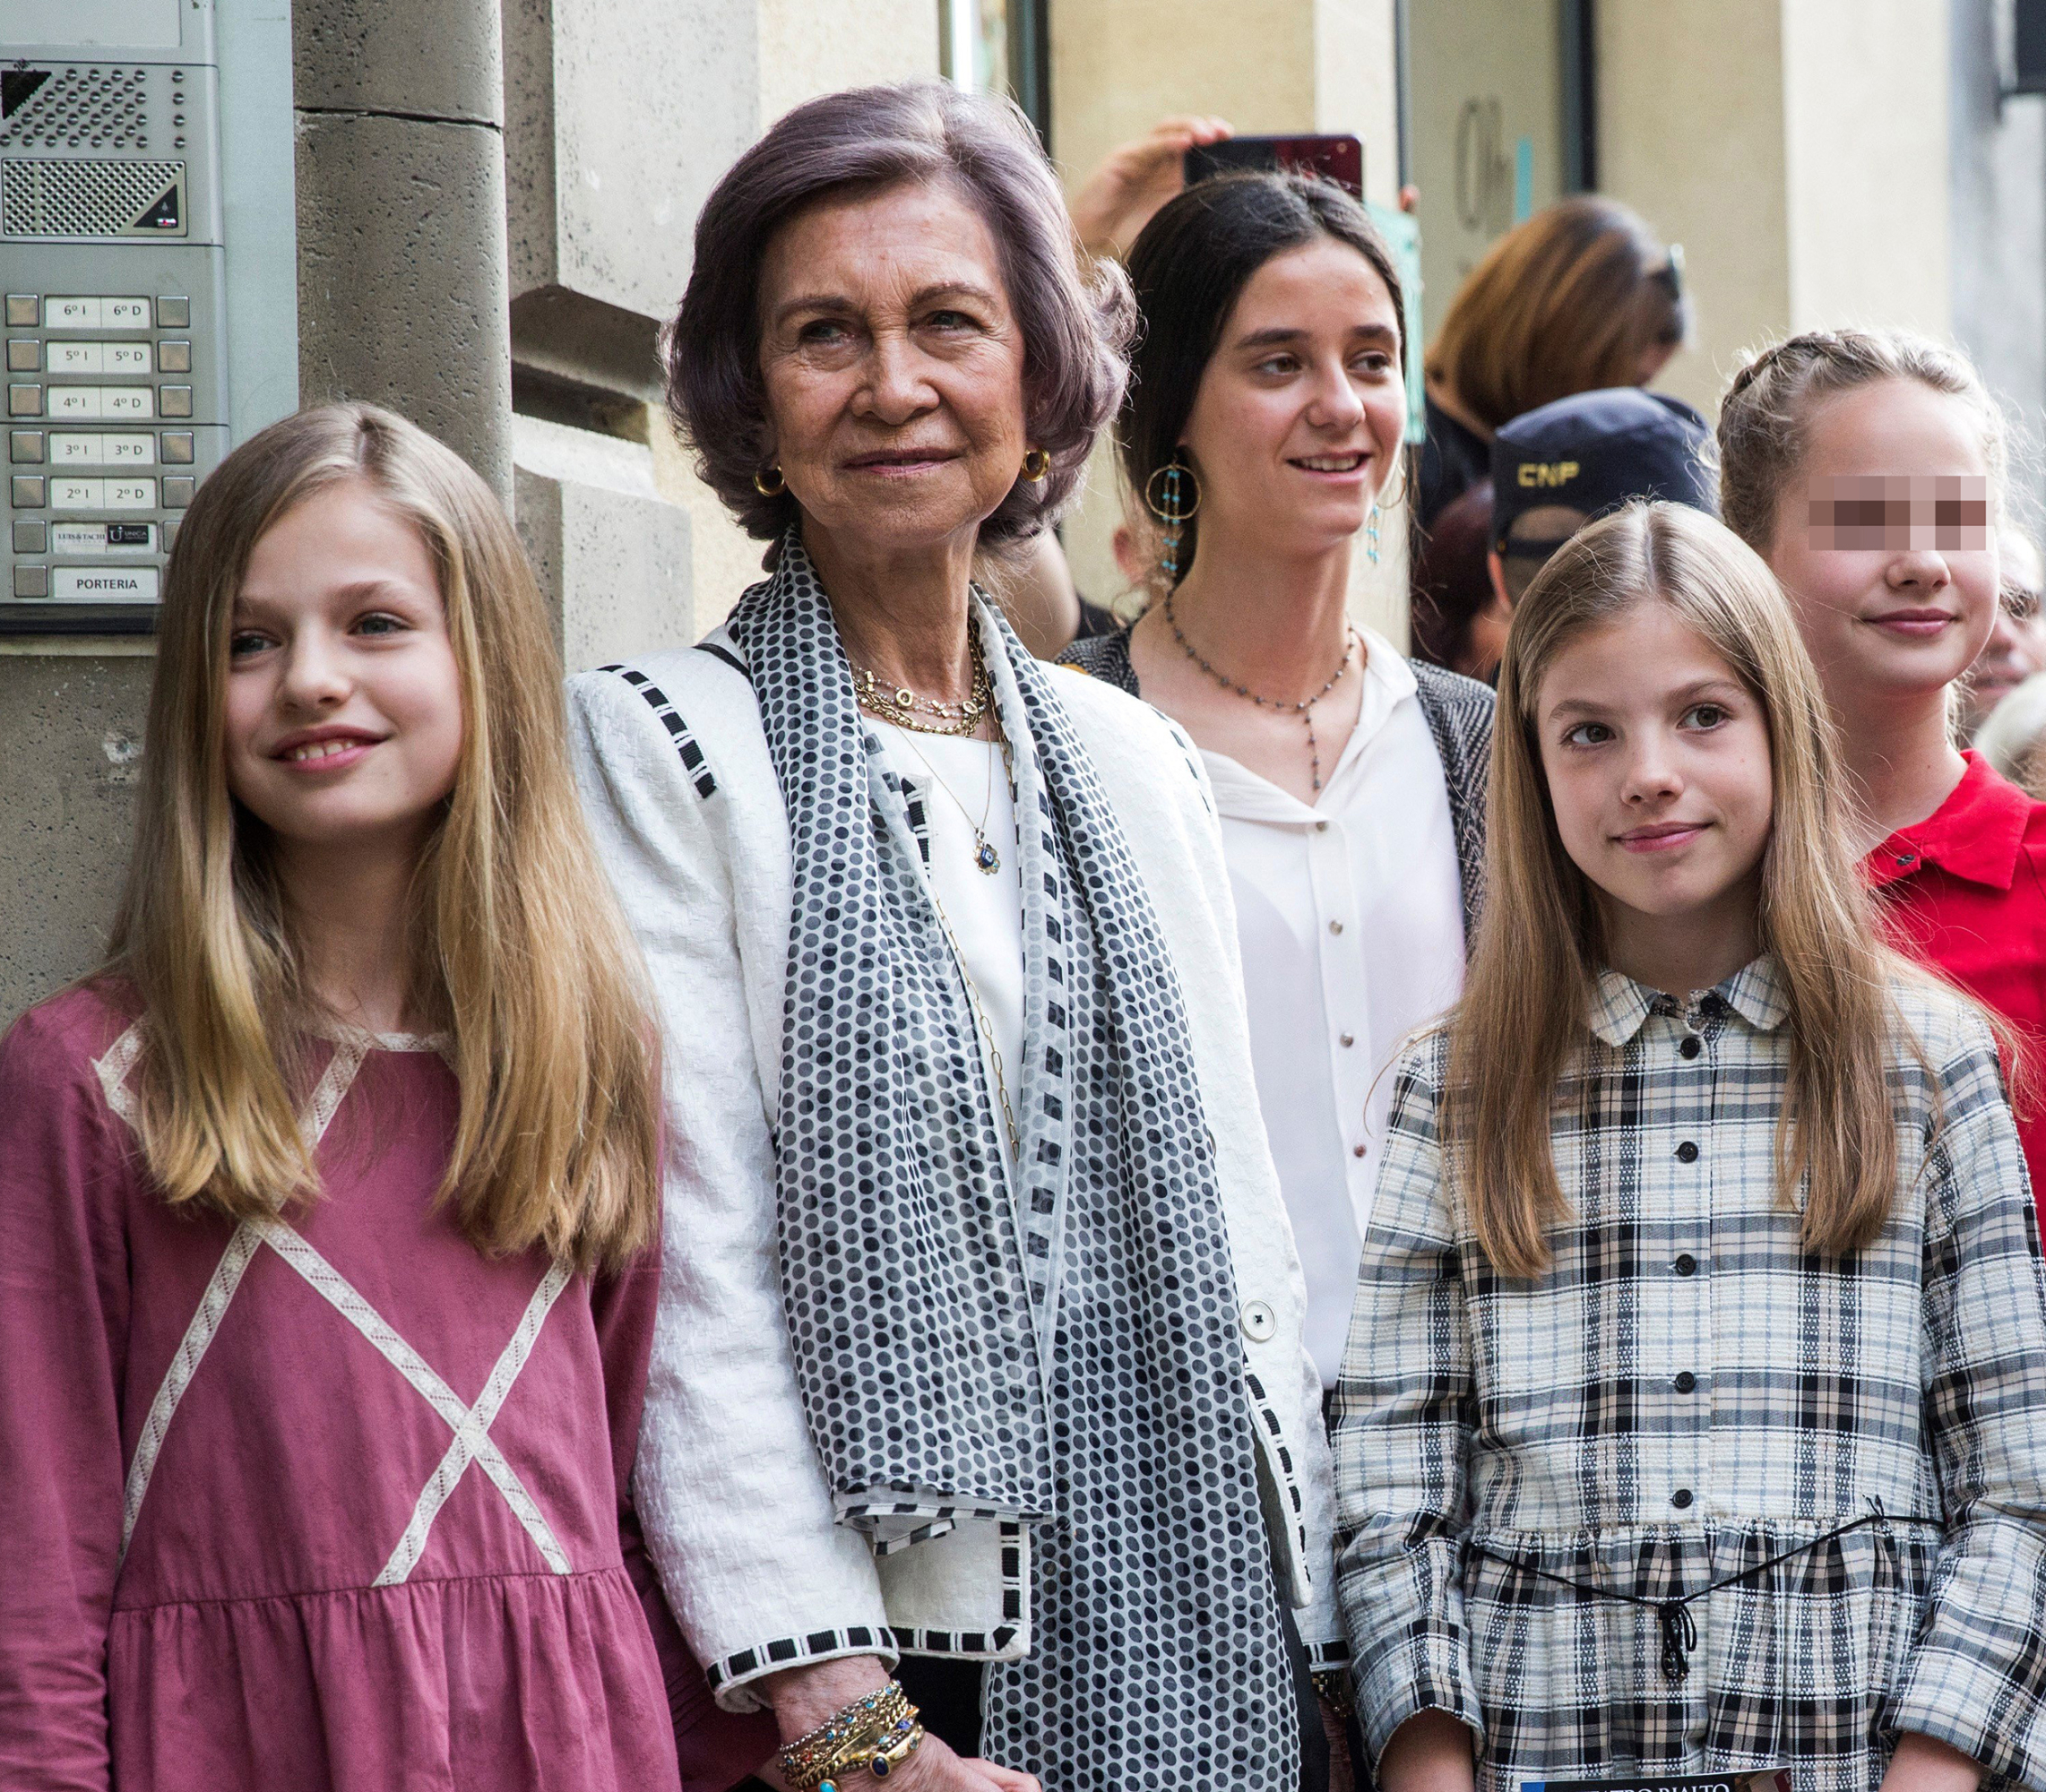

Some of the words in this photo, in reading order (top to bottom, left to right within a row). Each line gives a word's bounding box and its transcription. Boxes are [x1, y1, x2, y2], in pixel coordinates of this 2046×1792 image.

[132, 306, 142, 316] D
[134, 351, 143, 362] D
[132, 398, 142, 409] D
[134, 445, 142, 455] D
[1517, 461, 1580, 487] CNP
[135, 489, 144, 499] D
[76, 579, 138, 590] PORTERIA
